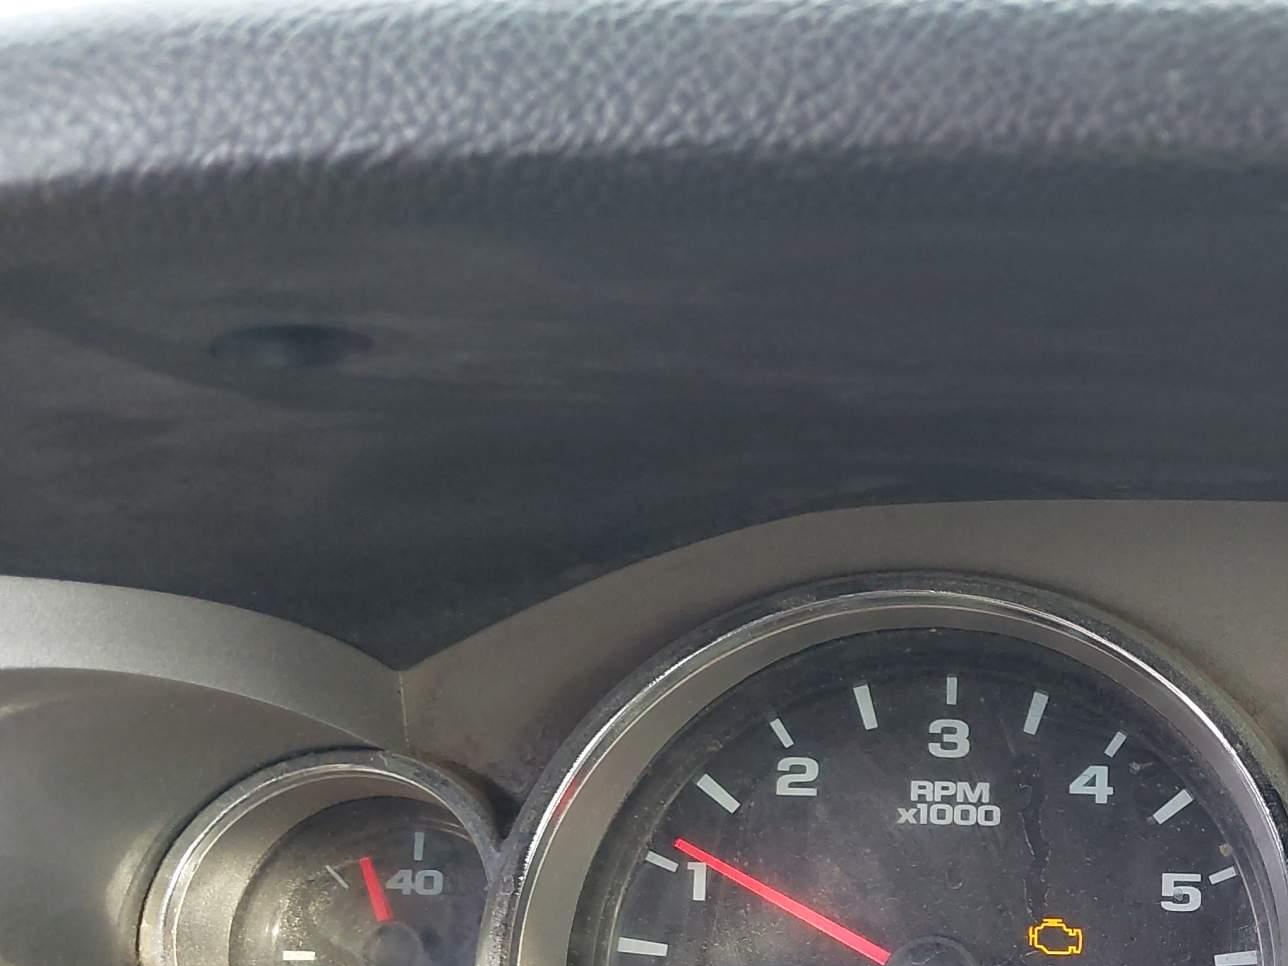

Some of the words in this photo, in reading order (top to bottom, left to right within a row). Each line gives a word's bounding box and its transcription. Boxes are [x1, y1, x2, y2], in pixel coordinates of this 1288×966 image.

[928, 719, 970, 759] 3
[776, 757, 820, 797] 2
[910, 780, 990, 803] RPM
[1069, 766, 1113, 804] 4
[898, 804, 1001, 827] x1000
[386, 869, 443, 896] 40
[687, 862, 707, 901] 1
[1160, 872, 1202, 912] 5
